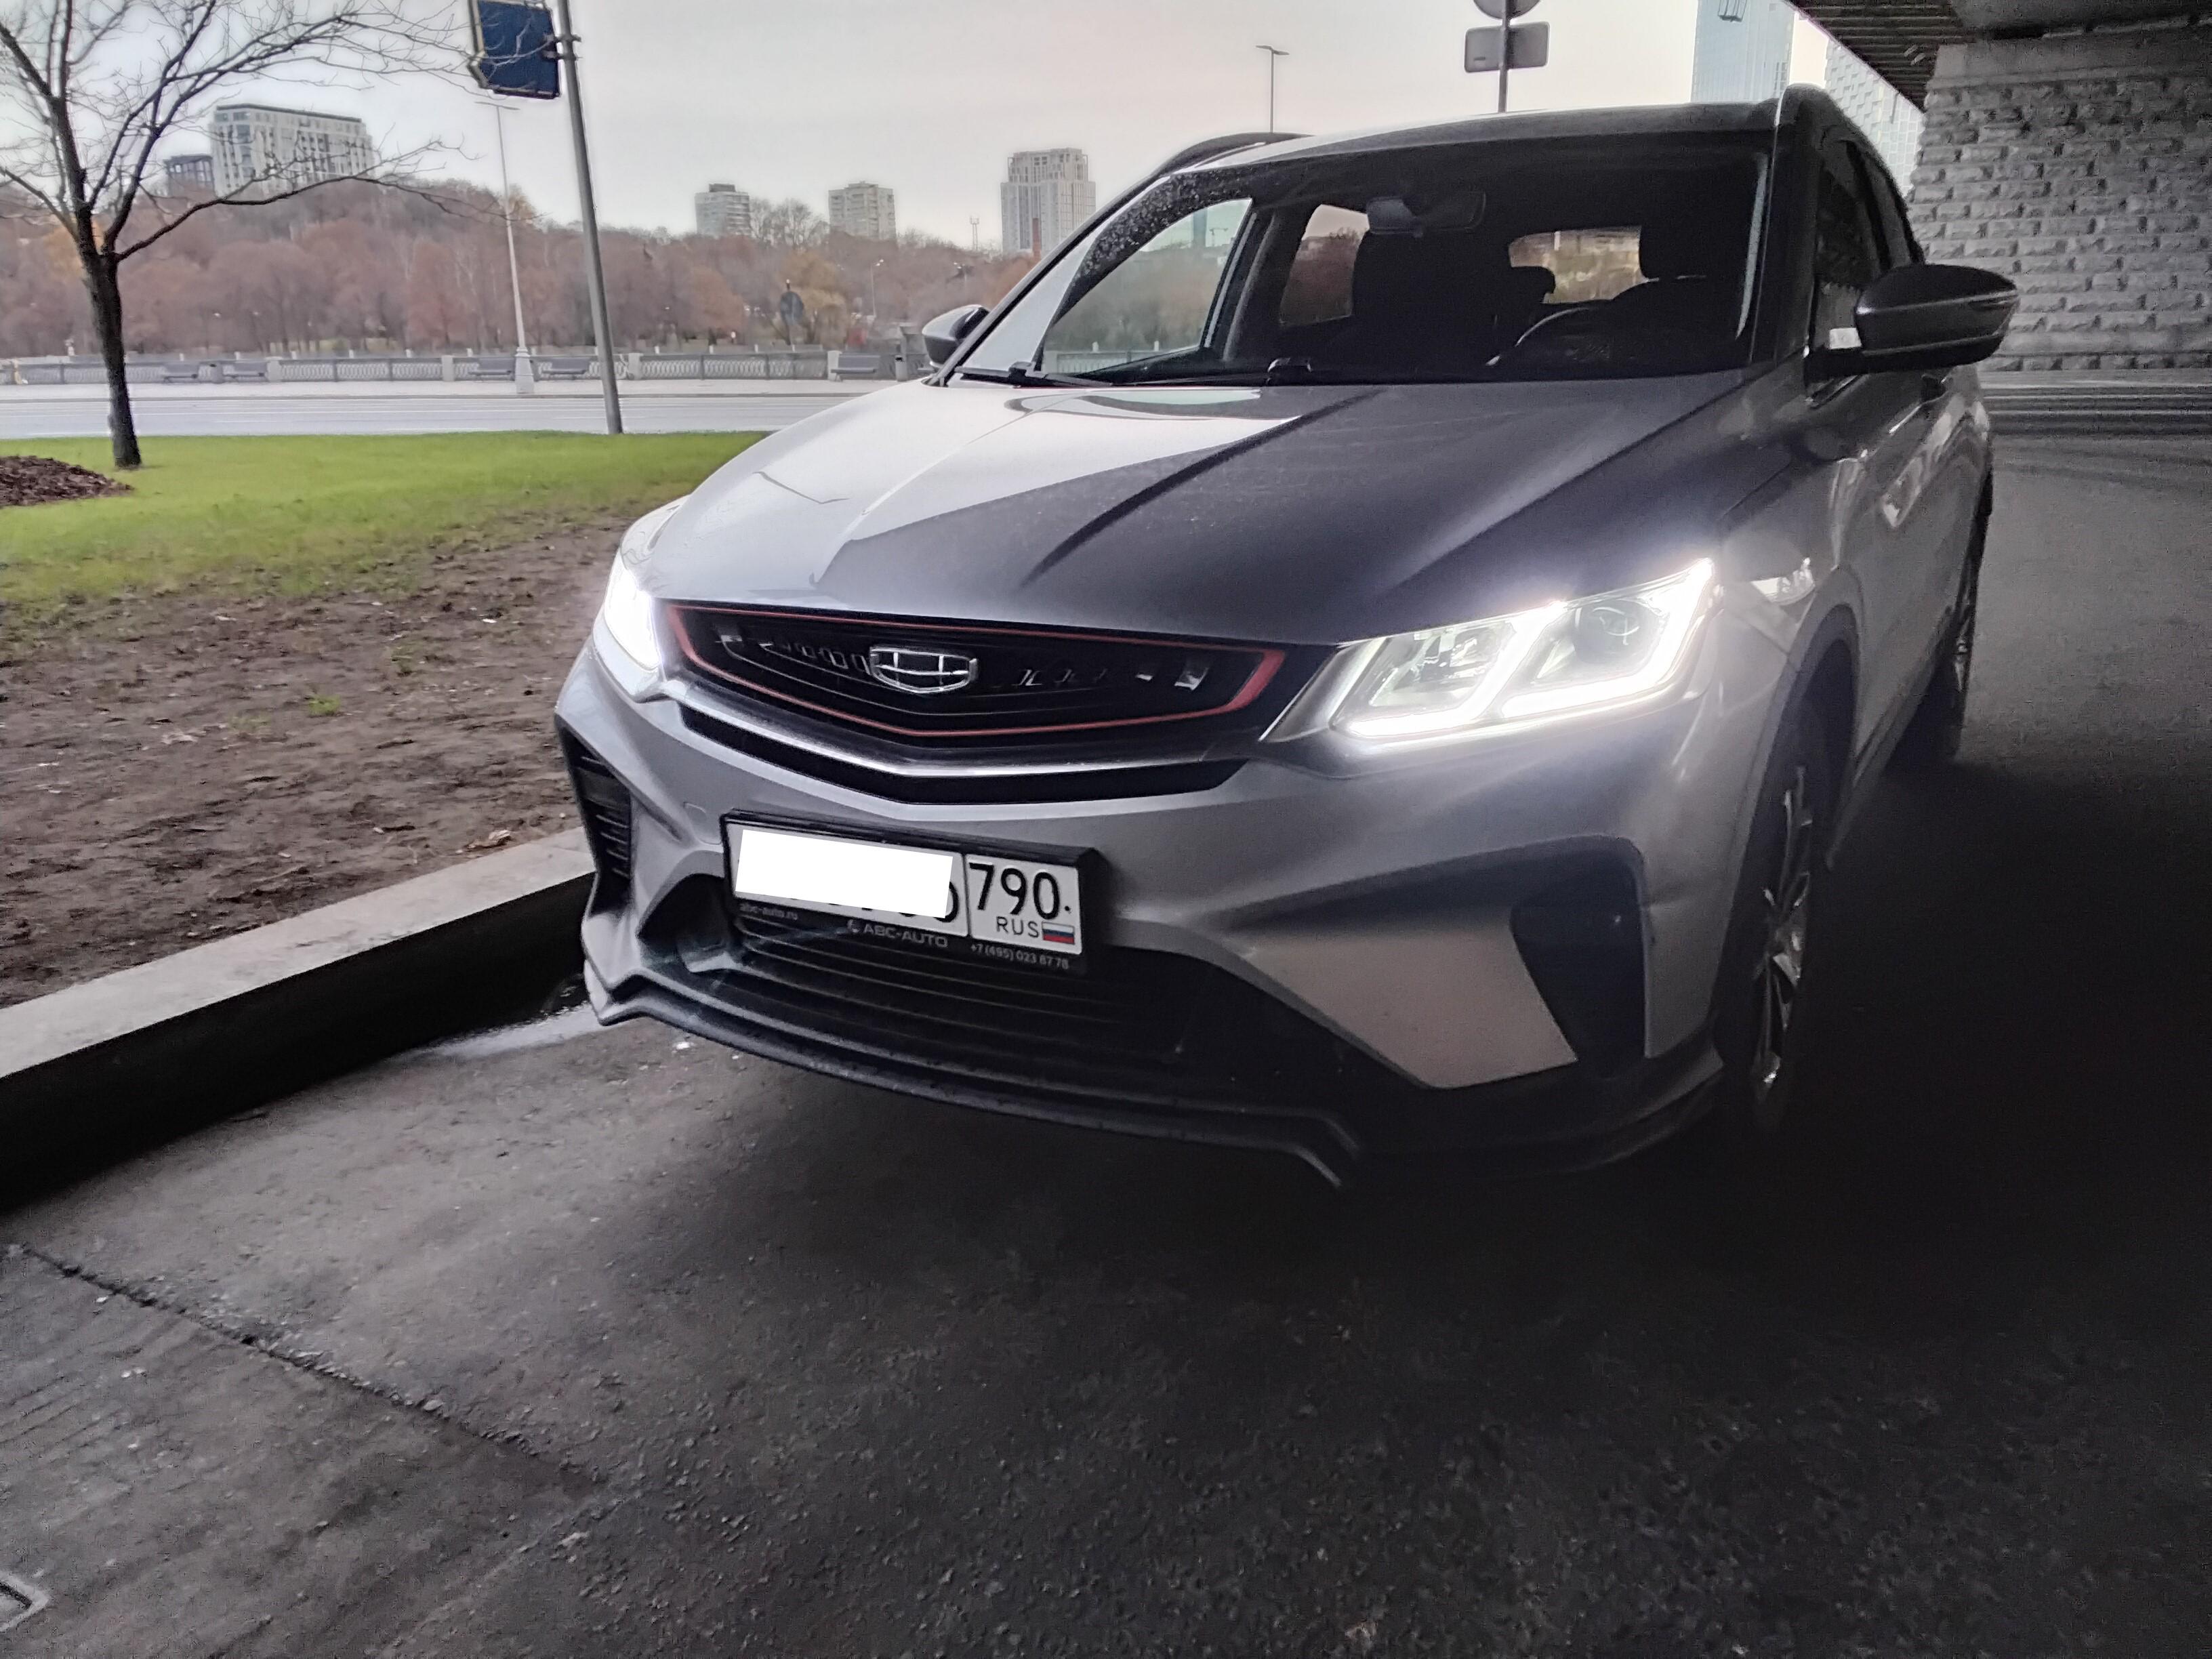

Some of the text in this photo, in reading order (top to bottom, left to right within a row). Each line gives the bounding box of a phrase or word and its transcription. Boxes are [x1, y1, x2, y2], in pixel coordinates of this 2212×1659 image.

[969, 862, 1060, 920] 790
[863, 923, 948, 947] ABC-AUTO
[996, 916, 1039, 938] RUS
